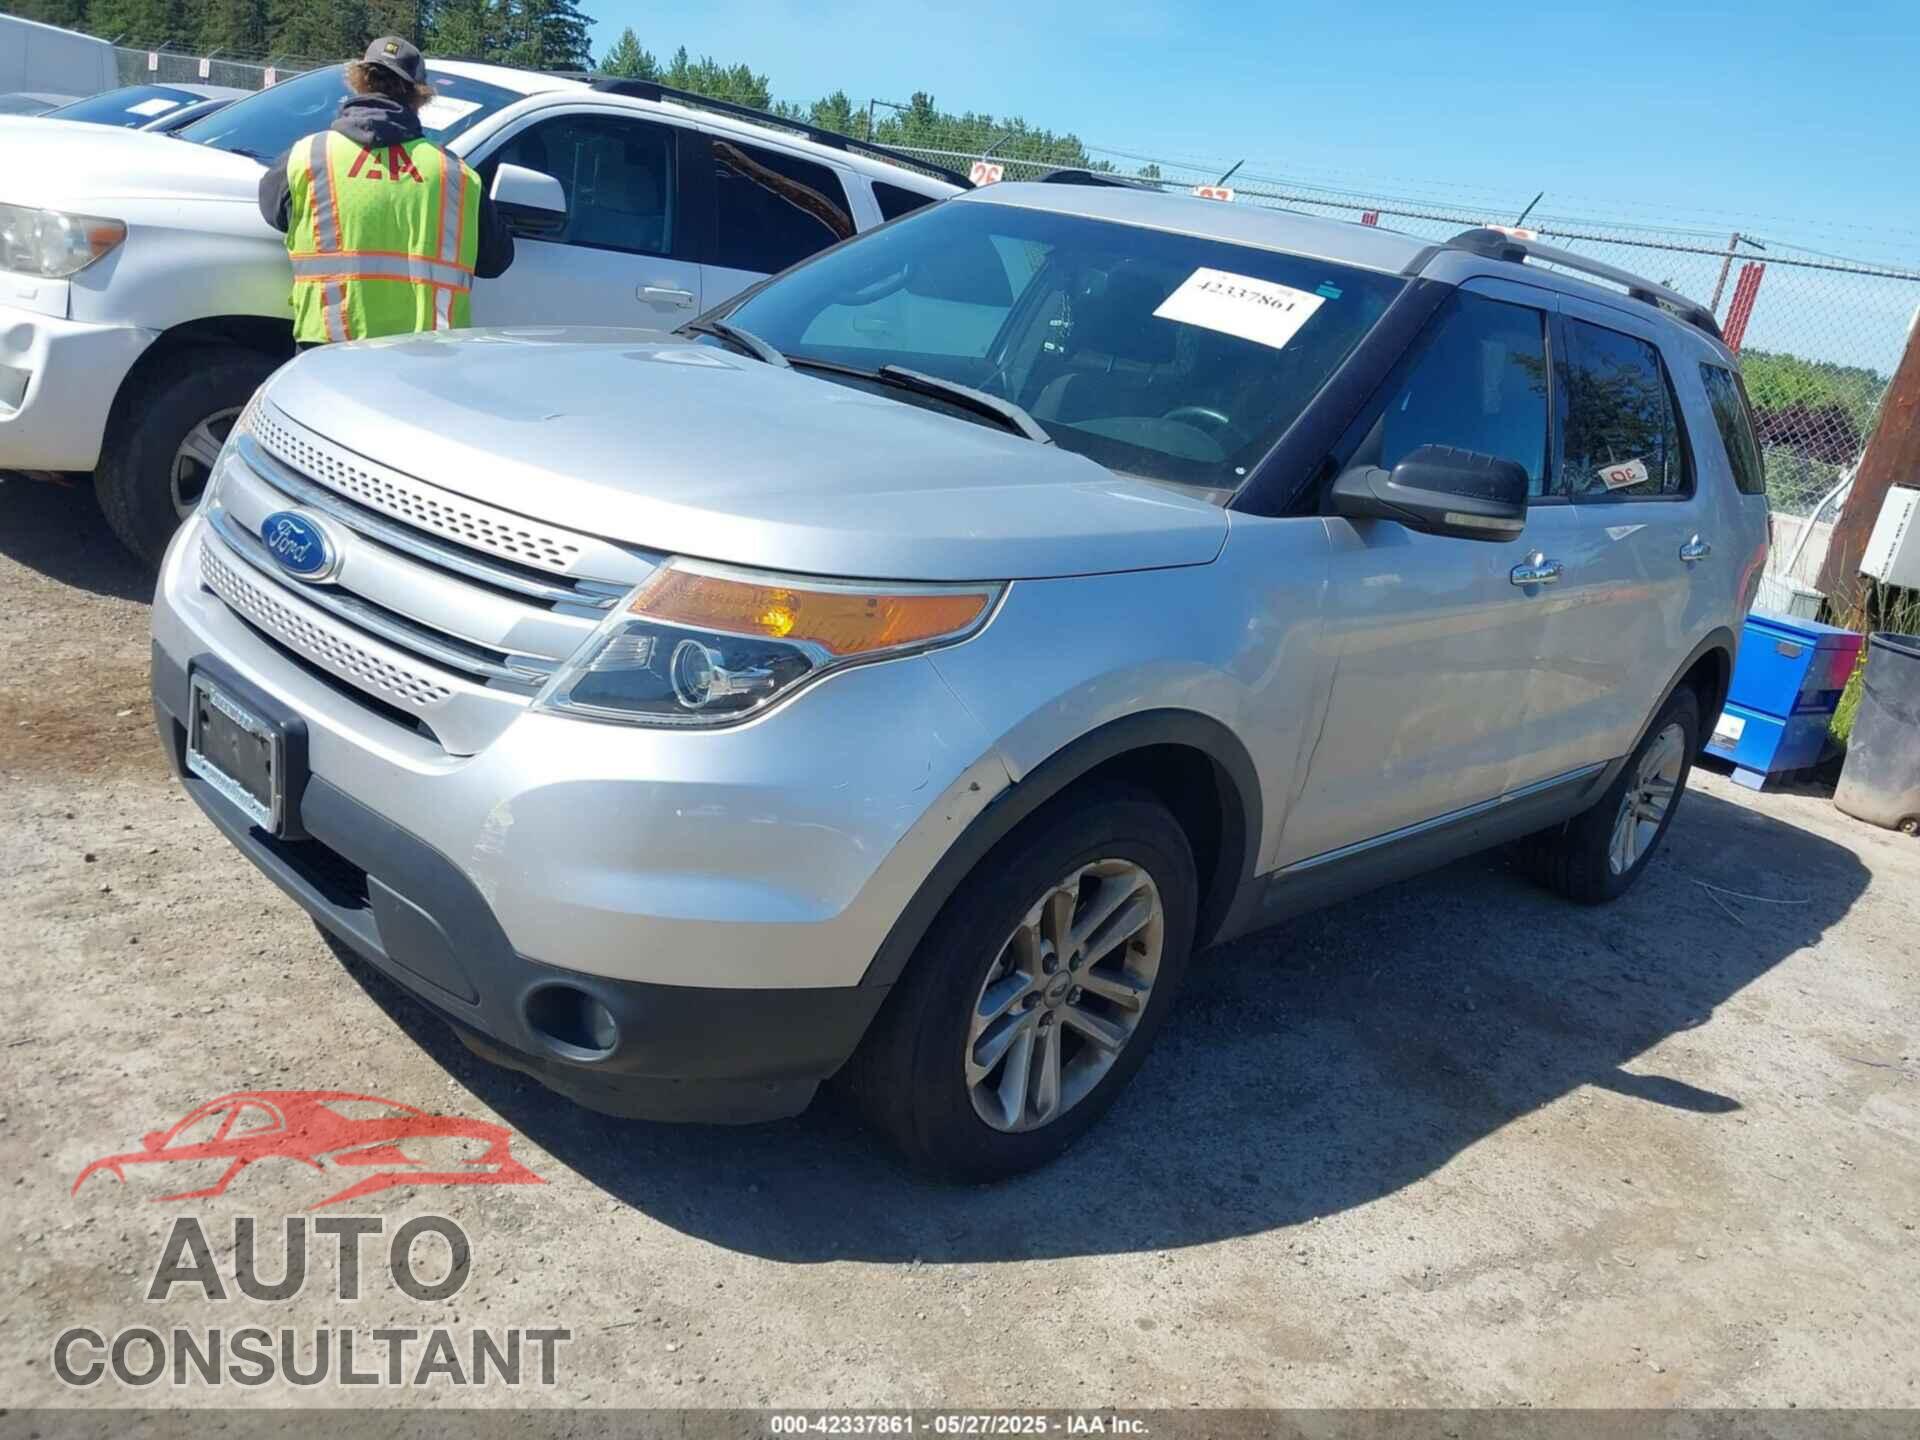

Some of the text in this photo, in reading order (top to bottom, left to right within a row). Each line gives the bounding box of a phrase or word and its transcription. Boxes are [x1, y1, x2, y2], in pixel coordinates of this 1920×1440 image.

[974, 164, 999, 184] 26
[1198, 280, 1297, 313] 42337861
[269, 519, 313, 563] Ford
